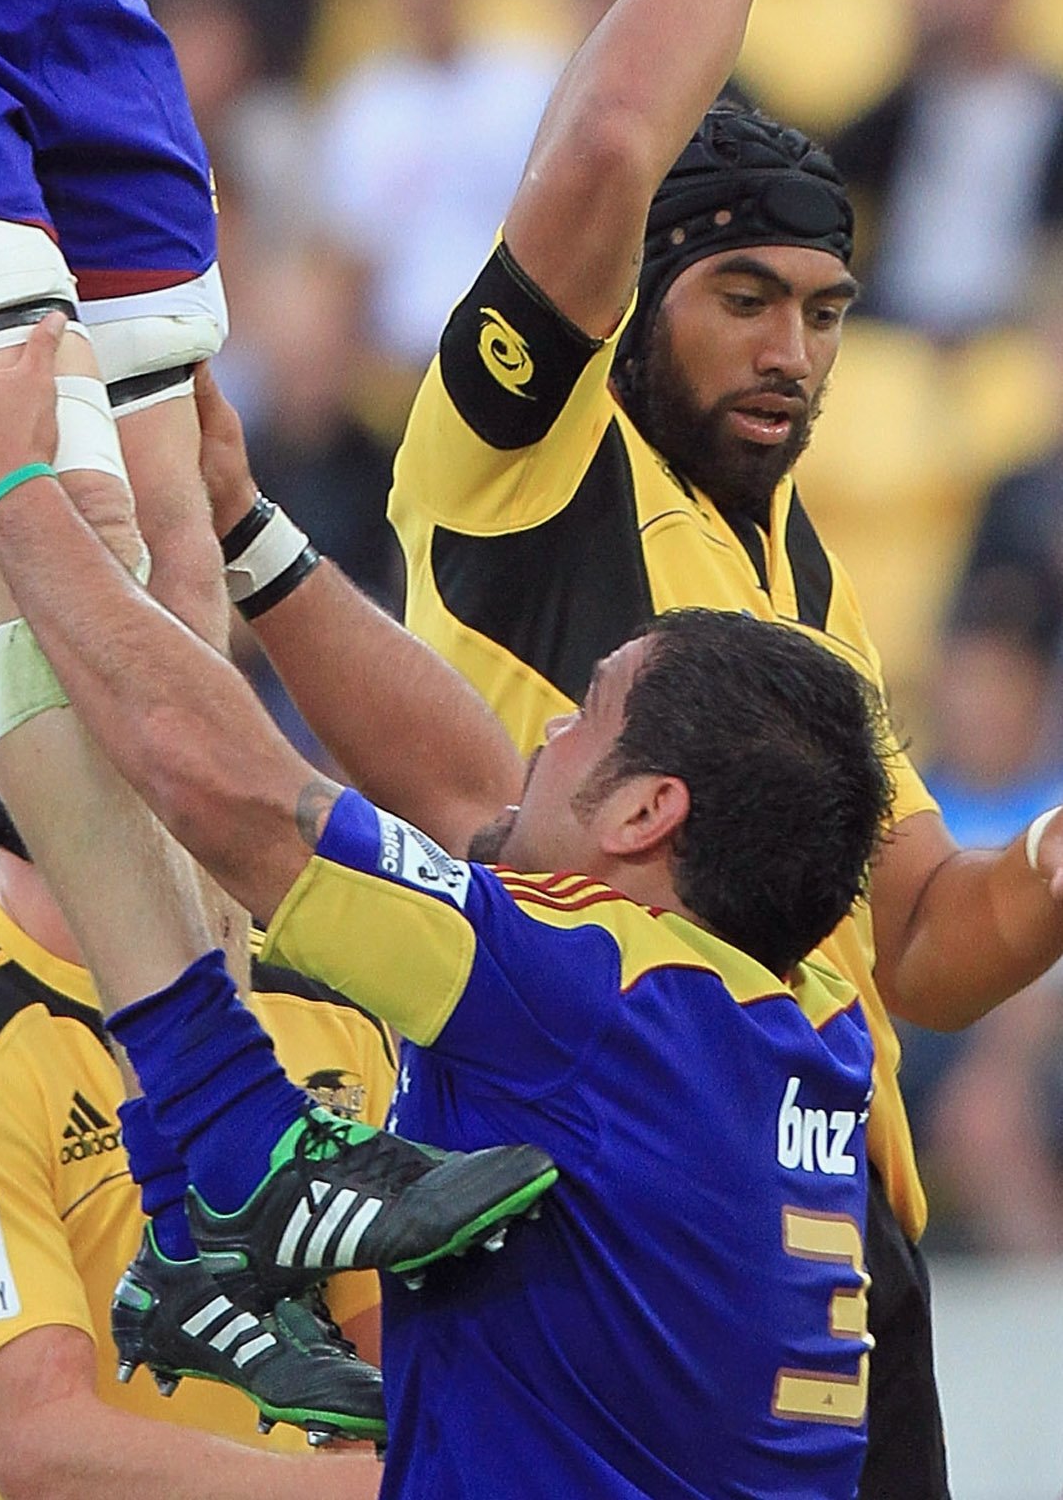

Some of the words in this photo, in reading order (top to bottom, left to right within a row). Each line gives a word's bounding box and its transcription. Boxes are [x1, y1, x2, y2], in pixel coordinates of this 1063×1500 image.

[60, 1128, 123, 1165] adida
[777, 1076, 856, 1176] bnz
[772, 1204, 876, 1428] 3
